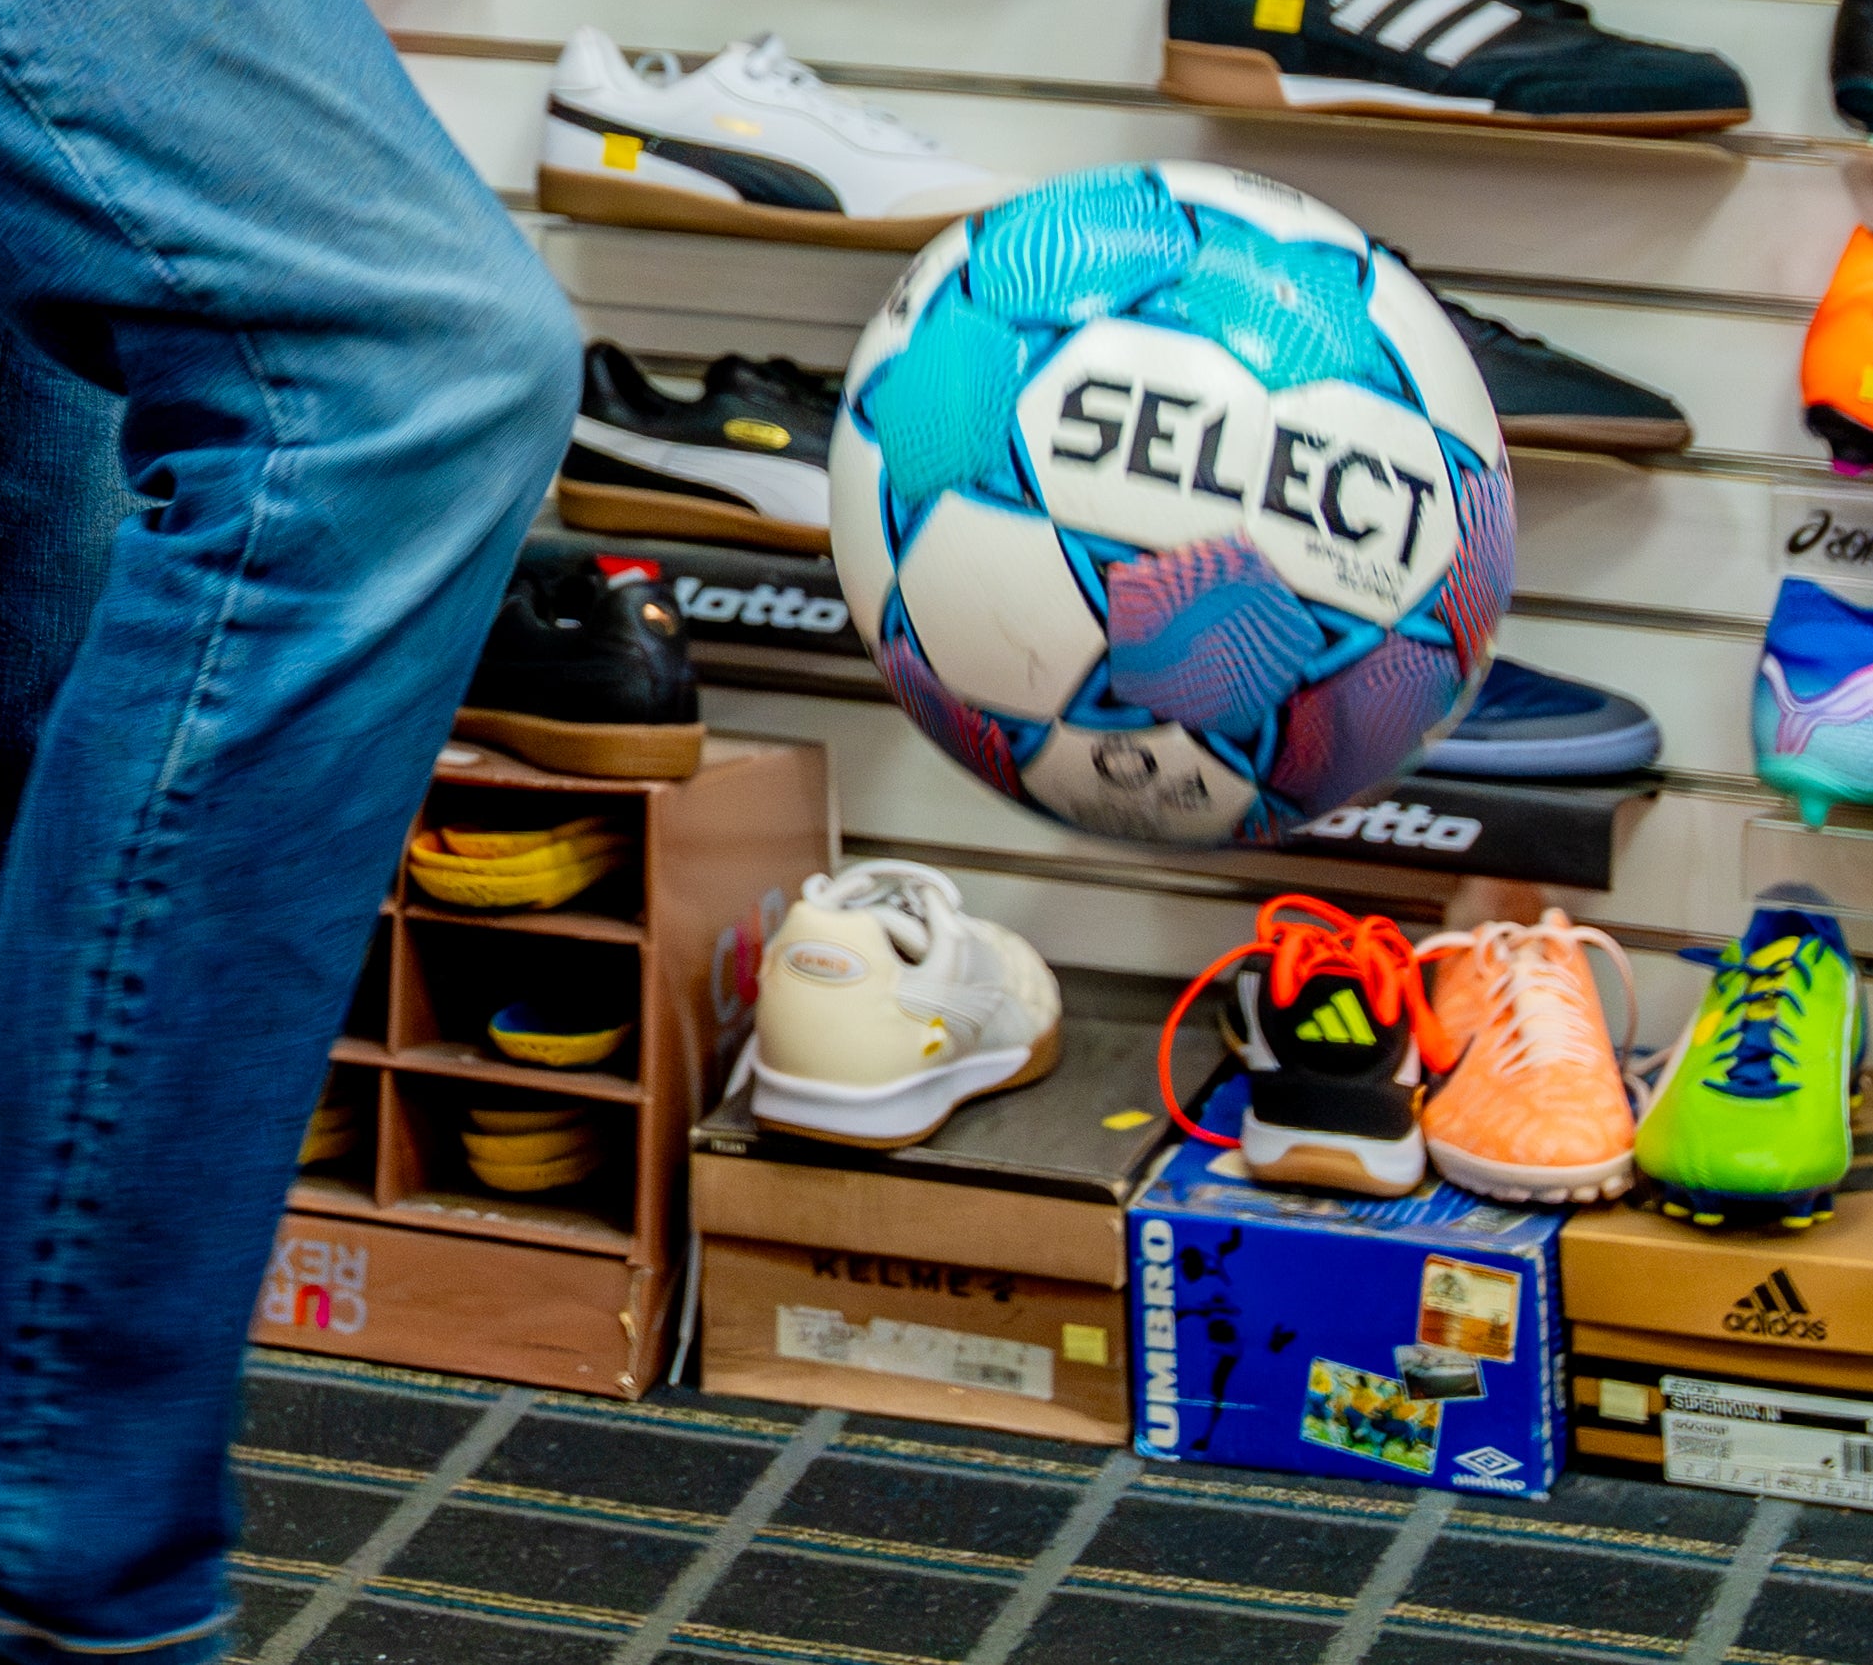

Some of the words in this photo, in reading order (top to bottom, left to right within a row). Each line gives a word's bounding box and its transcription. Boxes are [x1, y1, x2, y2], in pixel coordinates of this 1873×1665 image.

[1051, 379, 1437, 569] SELECT
[1293, 801, 1483, 853] otto
[812, 1254, 971, 1298] KELME
[1140, 1219, 1180, 1450] UMBRO
[1722, 1307, 1828, 1341] adidas
